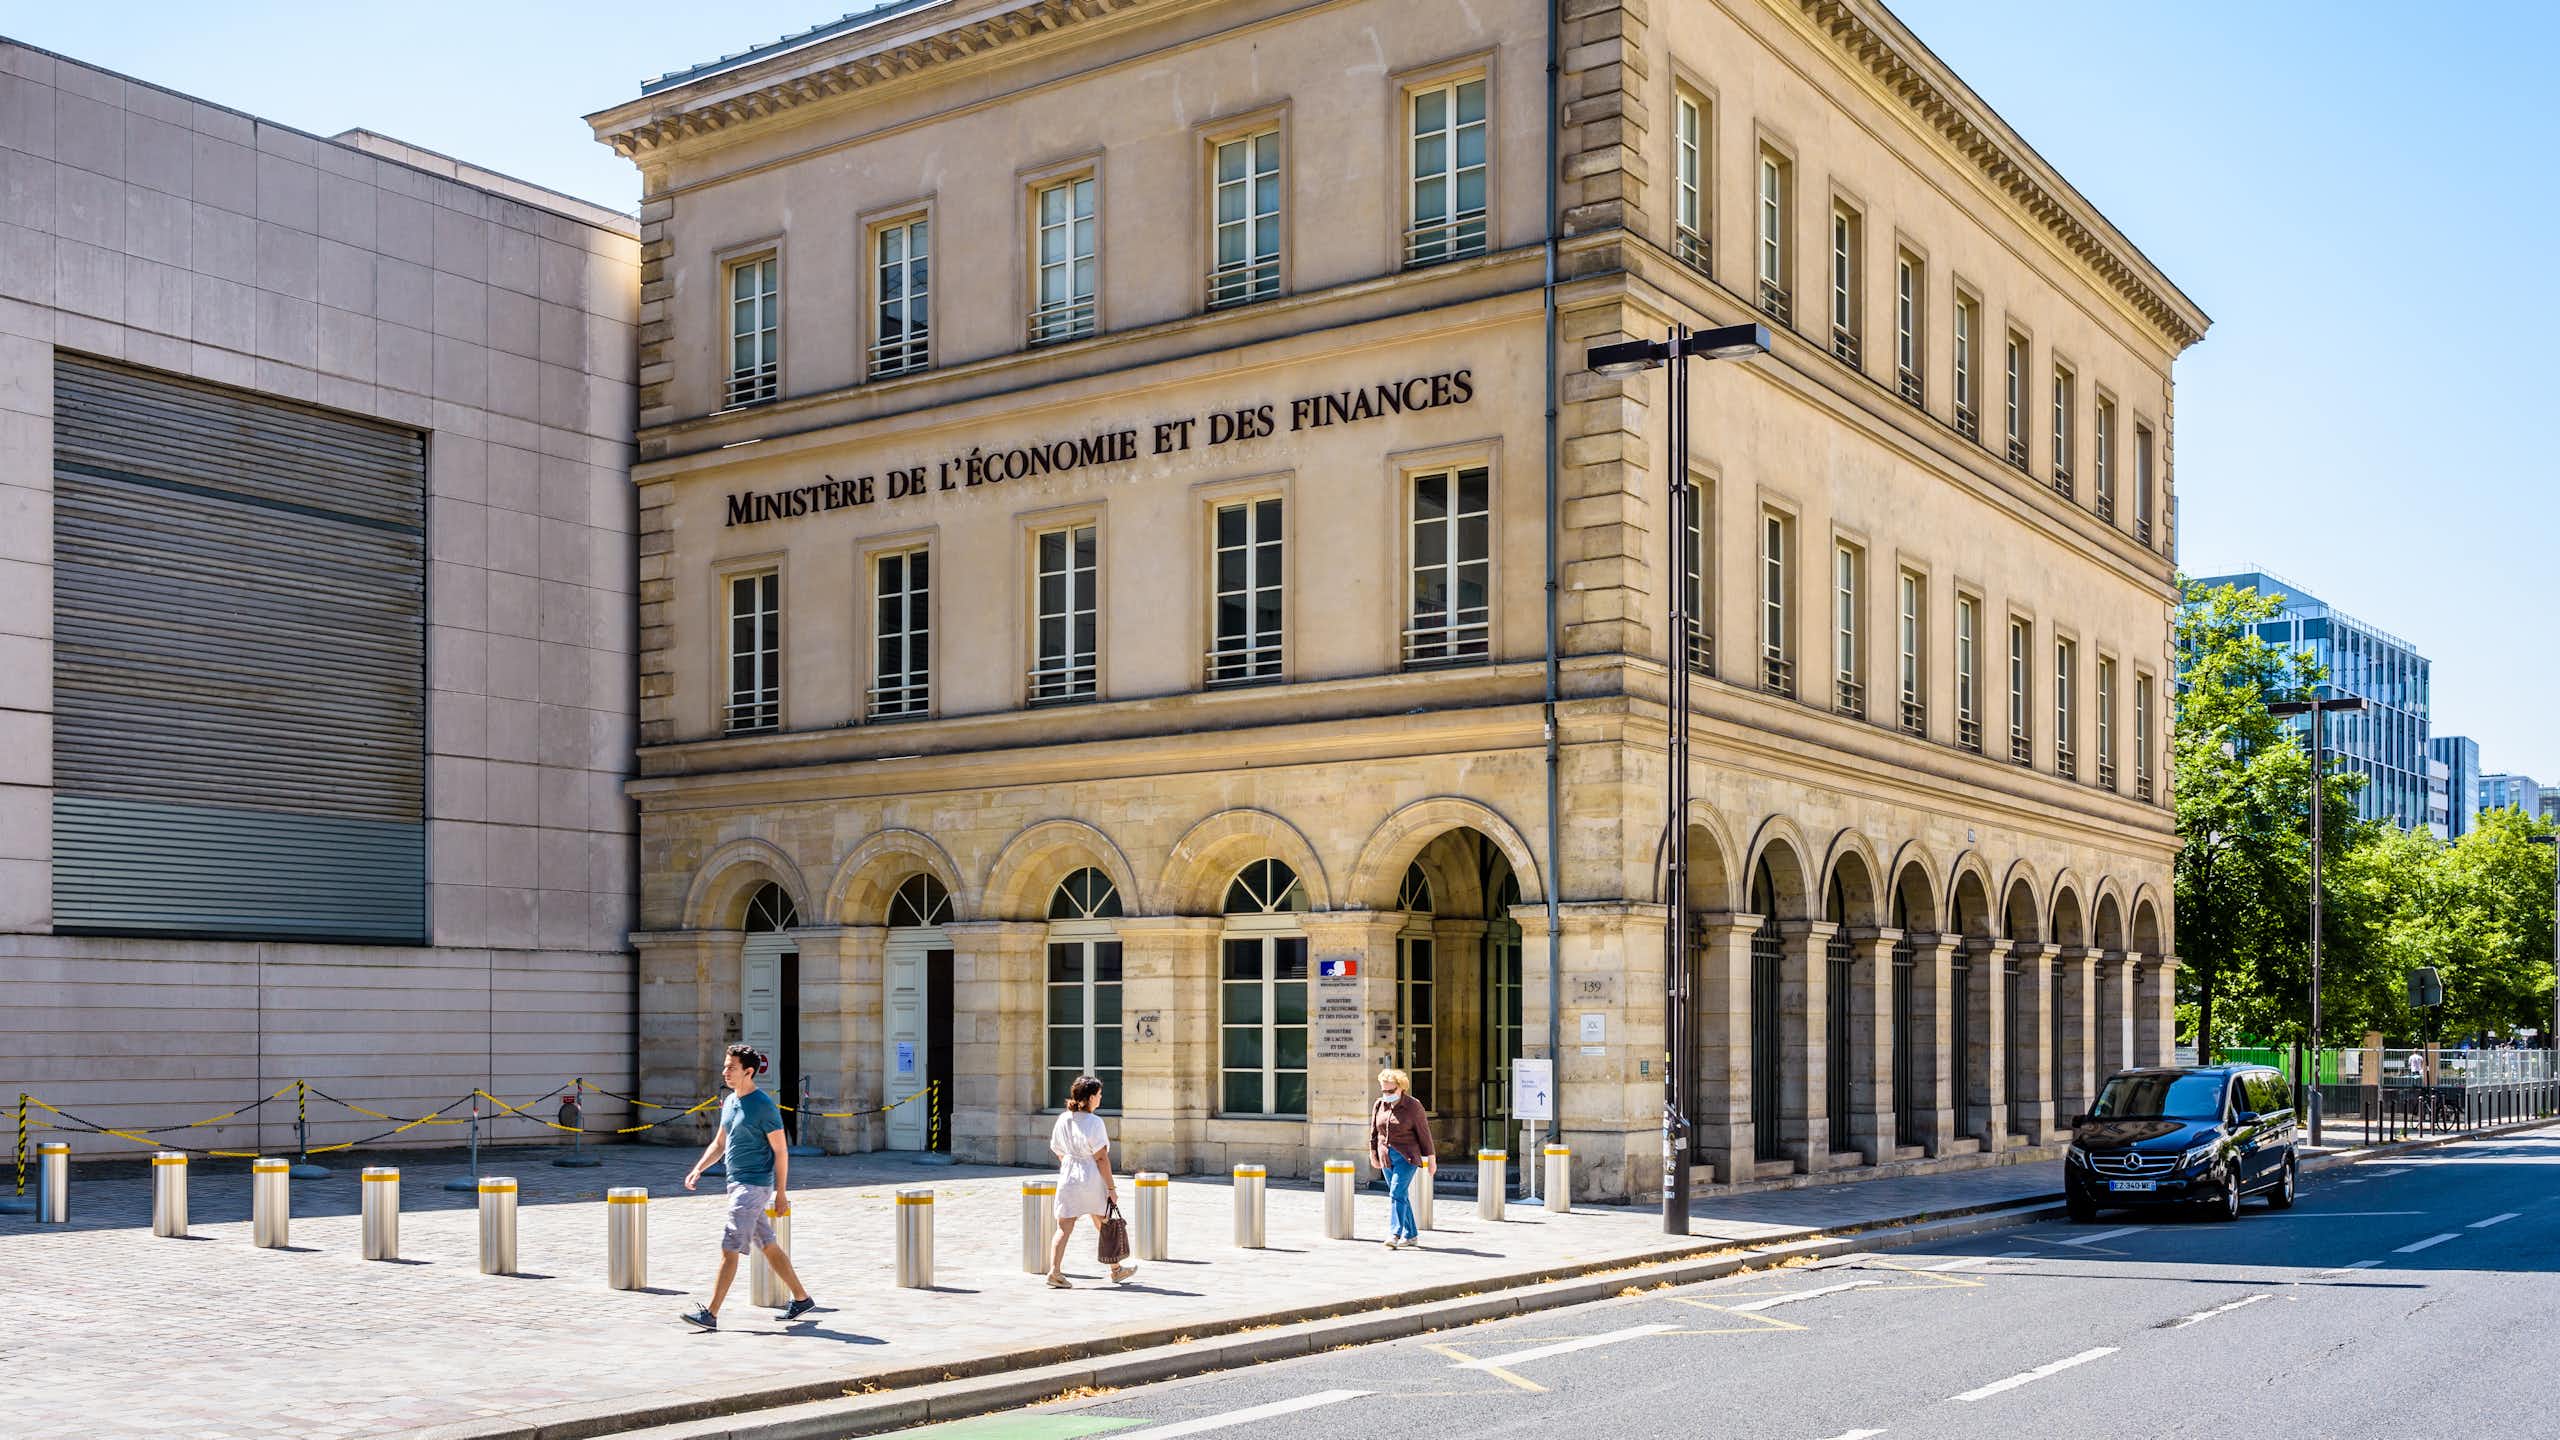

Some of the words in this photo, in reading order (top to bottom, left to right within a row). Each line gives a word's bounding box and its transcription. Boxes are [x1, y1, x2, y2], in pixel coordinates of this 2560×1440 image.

[725, 475, 874, 527] MINISTÈRE
[886, 467, 926, 500] DE
[938, 430, 1137, 491] L'ÉCONOMIE
[1151, 417, 1196, 455] ET
[1207, 404, 1275, 446] DES
[1290, 369, 1473, 432] FINANCES
[1583, 980, 1602, 993] 139
